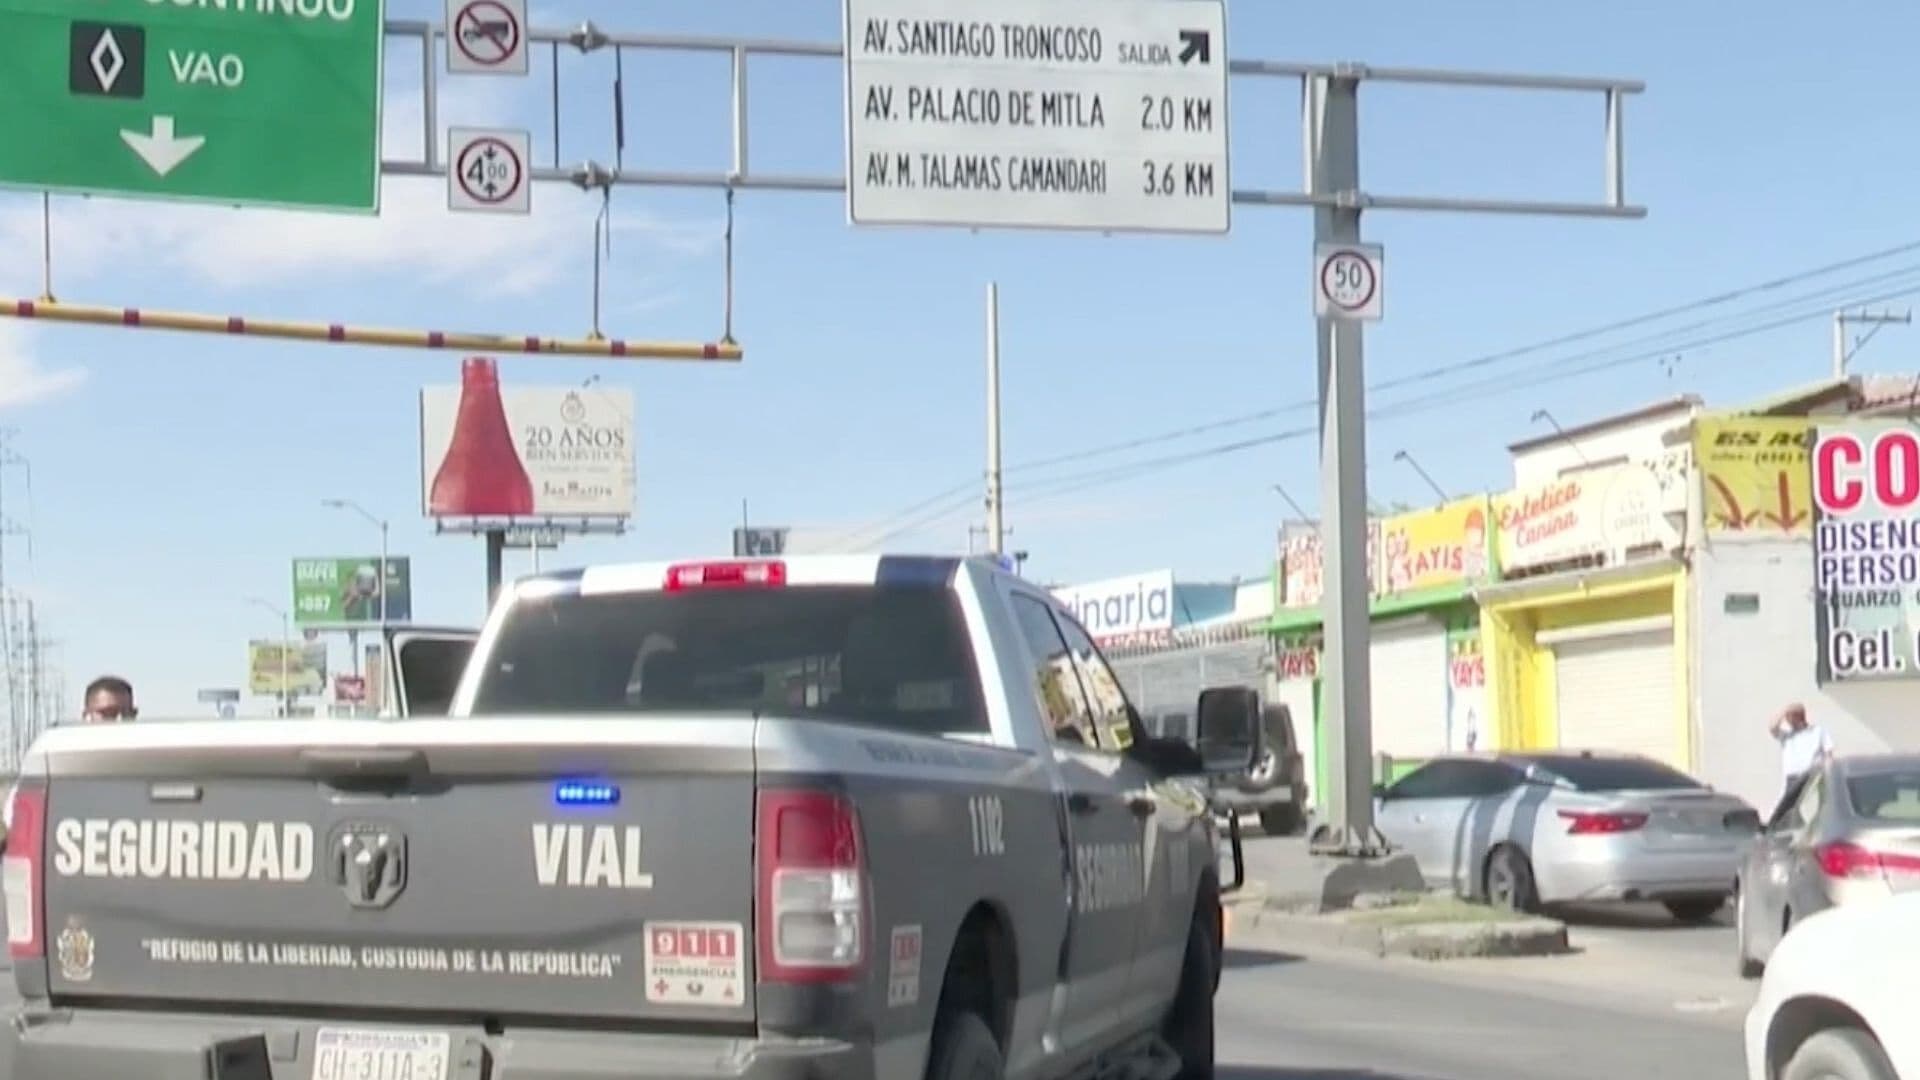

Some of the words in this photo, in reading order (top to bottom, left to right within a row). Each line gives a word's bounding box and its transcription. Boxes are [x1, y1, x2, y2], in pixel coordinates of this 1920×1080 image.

[864, 18, 892, 54] AV.
[897, 19, 995, 57] SANTIAGO
[1001, 24, 1102, 62] TRONCOSO
[1118, 42, 1172, 65] SALIDA
[168, 49, 245, 87] VAO
[865, 85, 898, 121] AV.
[908, 87, 1000, 125] PALACIO
[1008, 90, 1035, 126] DE
[1042, 92, 1104, 128] MITLA
[1141, 95, 1174, 131] 2.0
[1184, 96, 1212, 132] KM
[866, 152, 893, 187] AV.
[897, 152, 916, 188] M.
[921, 153, 1002, 190] TALAMAS
[1008, 156, 1107, 195] CAMANDARI
[1143, 159, 1175, 196] 3.6
[1185, 161, 1214, 197] KM
[1335, 260, 1362, 289] 50
[525, 424, 553, 448] 20
[560, 421, 625, 449] AÑOS
[1714, 431, 1761, 447] ES
[1516, 510, 1578, 548] Canina
[1833, 629, 1902, 672] Cel.
[968, 795, 1006, 856] 1102
[54, 818, 313, 882] SEGURIDAD
[532, 823, 654, 889] VIAL
[141, 937, 218, 962] "REFUGIO
[222, 940, 244, 963] DE
[247, 941, 270, 965] LA
[273, 943, 357, 969] LIBERTAD,
[361, 945, 448, 971] CUSTODIA
[452, 948, 476, 972] DE
[480, 948, 504, 972] LA
[657, 931, 728, 956] 911
